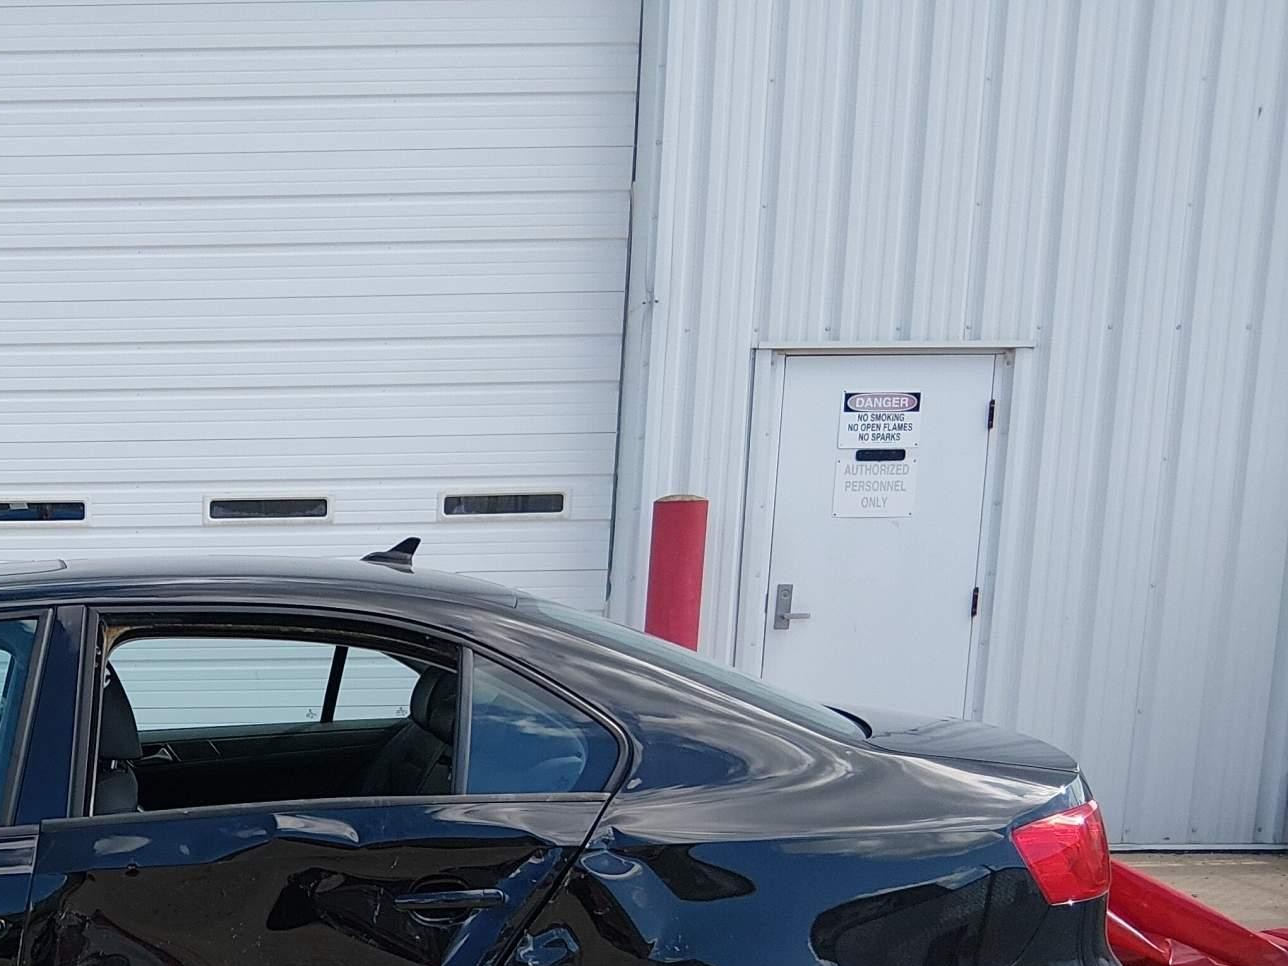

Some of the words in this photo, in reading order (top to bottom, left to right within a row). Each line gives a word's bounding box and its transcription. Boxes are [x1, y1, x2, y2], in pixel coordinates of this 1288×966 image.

[855, 397, 909, 408] DANGER
[857, 413, 869, 422] NO
[870, 413, 905, 422] SMOKING
[847, 423, 859, 432] NO
[860, 423, 882, 432] OPEN
[883, 422, 913, 432] FLAMES
[858, 432, 870, 441] NO
[871, 432, 901, 441] SPARKS
[844, 463, 910, 476] AUTHORIZED
[844, 480, 907, 492] PERSONNEL
[860, 496, 888, 508] ONLY
